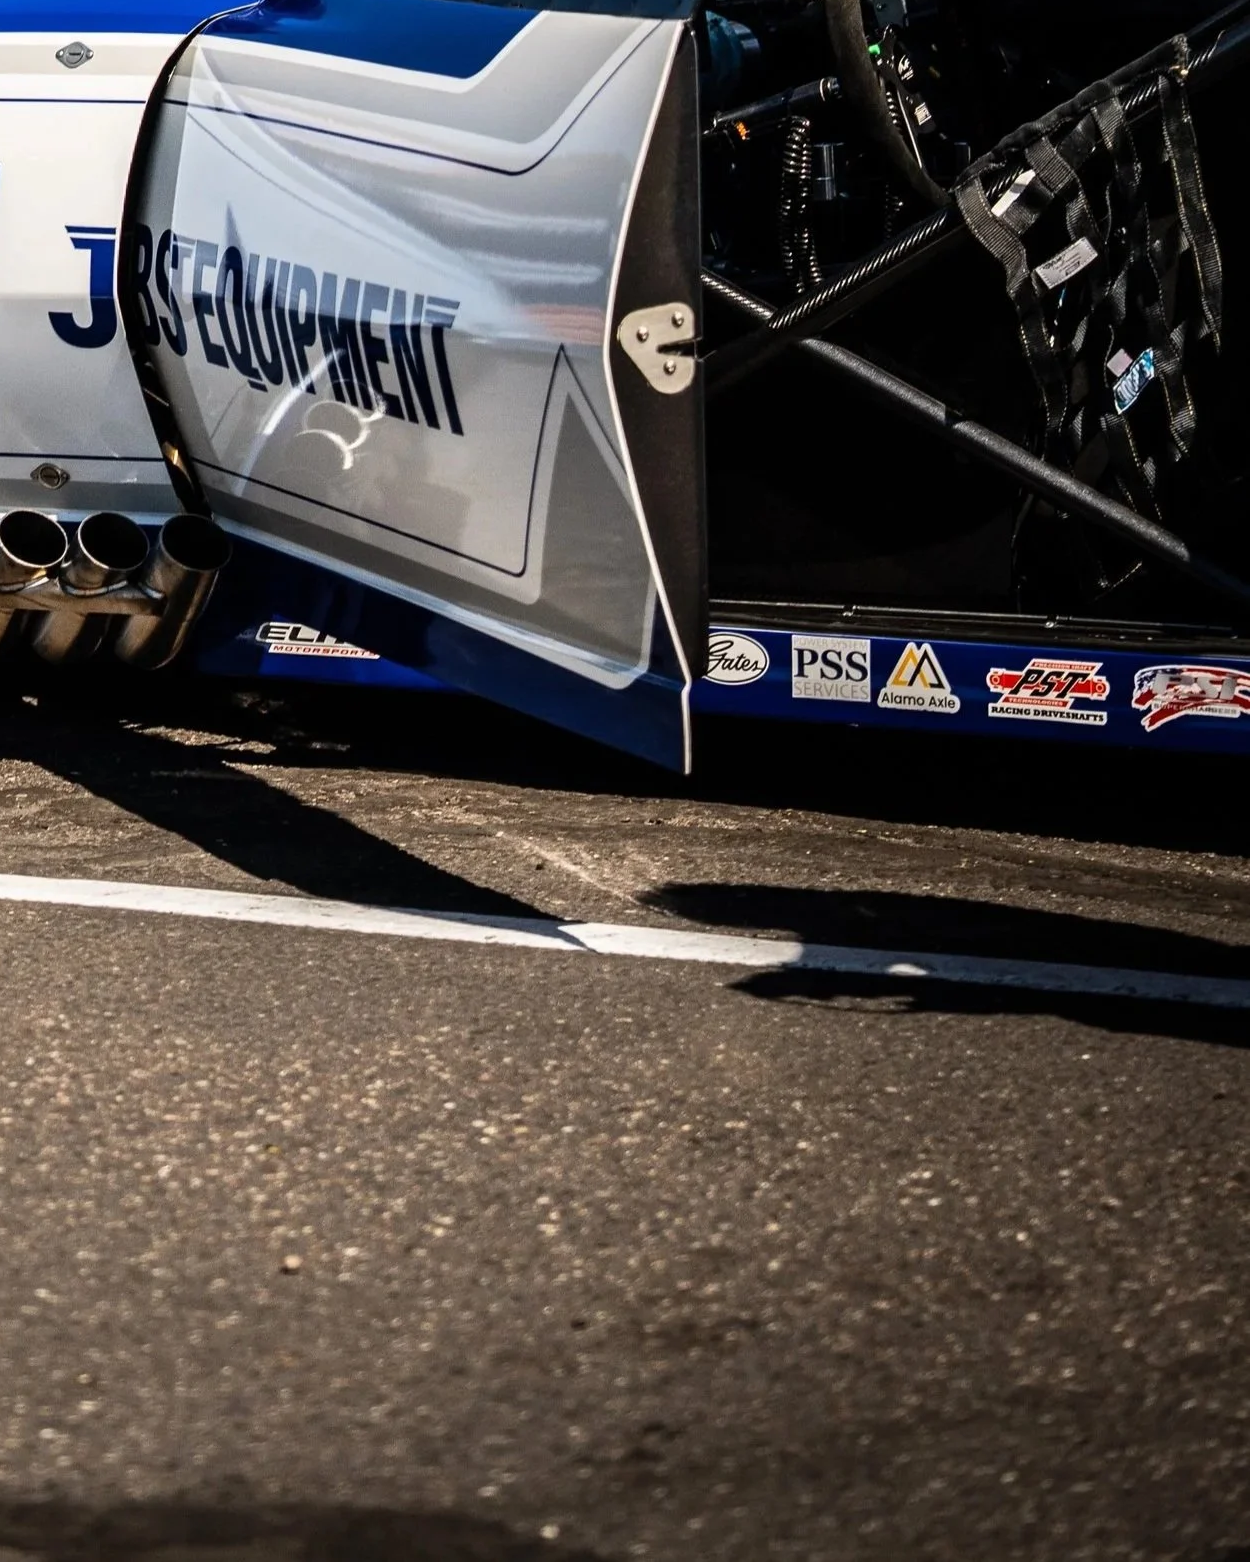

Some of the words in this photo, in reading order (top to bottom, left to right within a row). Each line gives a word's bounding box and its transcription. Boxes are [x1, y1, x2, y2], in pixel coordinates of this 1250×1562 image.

[192, 239, 464, 437] EQUIPMENT
[272, 645, 377, 657] MOTORSPORTS
[794, 638, 828, 647] POWER
[707, 640, 761, 674] Gates
[793, 647, 868, 682] PSS
[794, 681, 869, 700] SERVICES
[1010, 668, 1091, 698] PST
[881, 692, 925, 706] Alamo
[928, 696, 956, 709] Axle
[1008, 697, 1064, 706] TECHNOLOGIES
[991, 706, 1031, 715] RACING
[1033, 709, 1104, 722] DRIVESHAFTS
